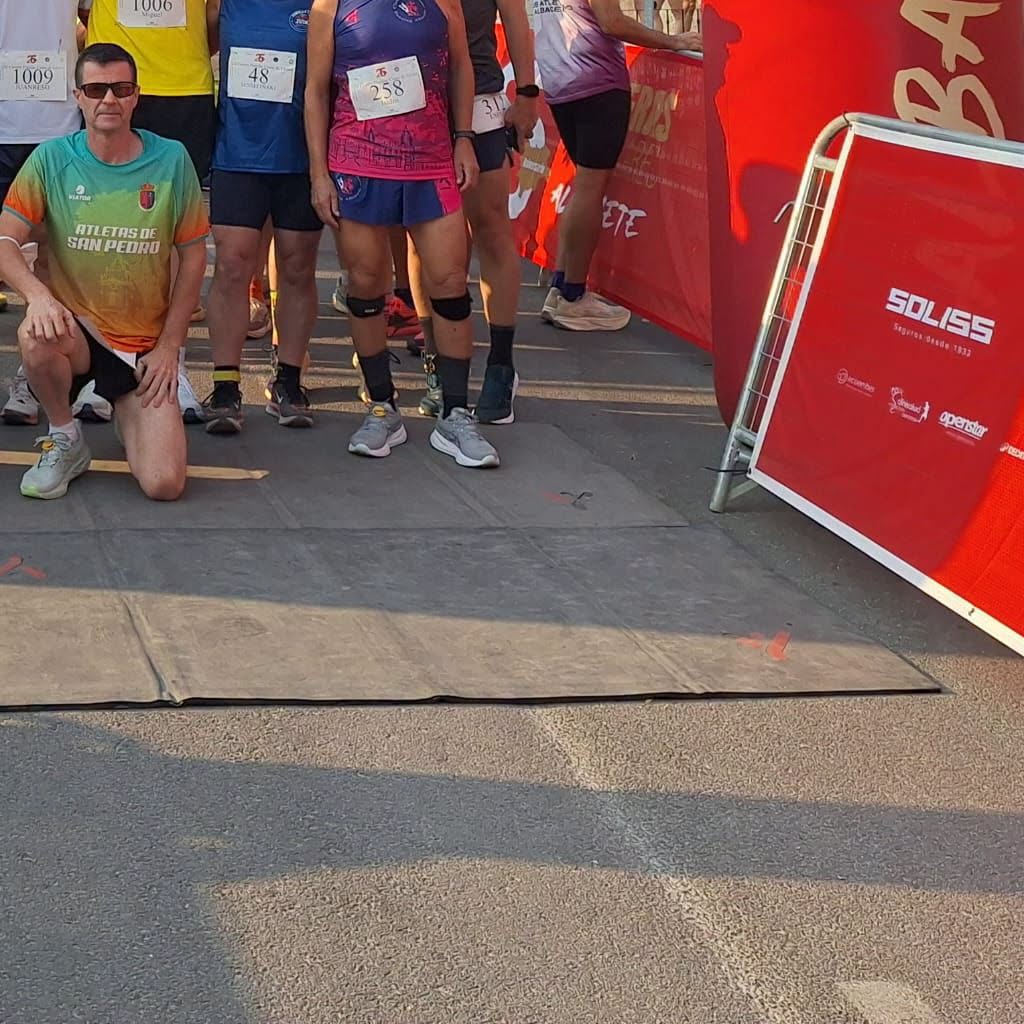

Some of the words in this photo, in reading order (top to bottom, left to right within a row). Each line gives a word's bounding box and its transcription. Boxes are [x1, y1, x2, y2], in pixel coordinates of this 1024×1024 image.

[13, 68, 54, 85] 1009
[248, 67, 270, 85] 48
[369, 79, 405, 102] 258
[75, 224, 138, 239] ATLETAS
[140, 227, 158, 240] DE
[67, 236, 102, 253] SAN
[104, 239, 161, 255] PEDRO
[885, 287, 996, 345] SOLISS
[893, 322, 923, 341] Seguros
